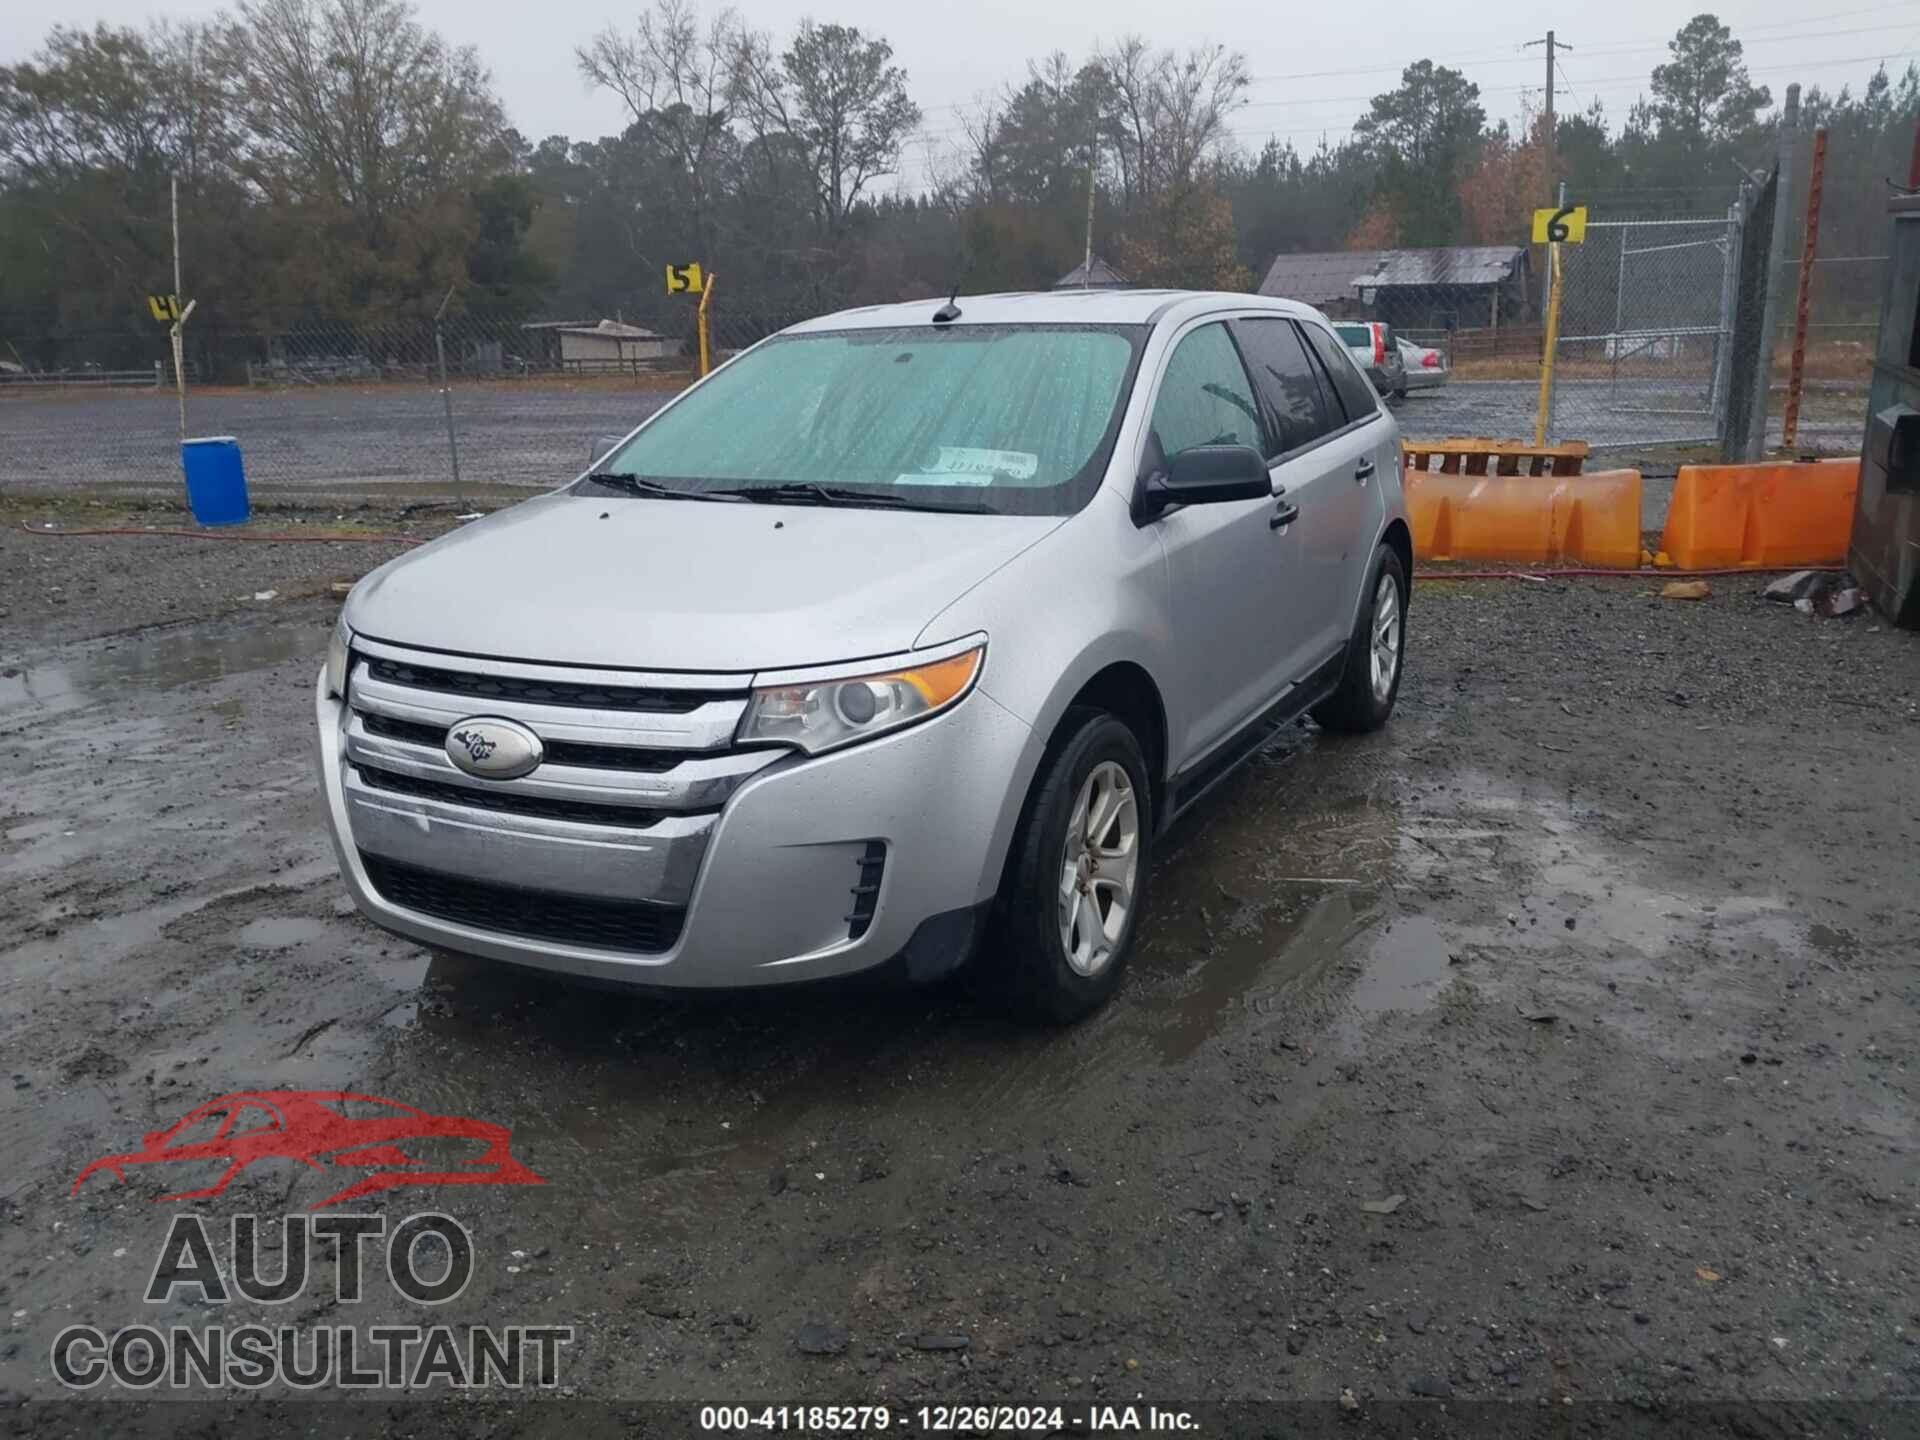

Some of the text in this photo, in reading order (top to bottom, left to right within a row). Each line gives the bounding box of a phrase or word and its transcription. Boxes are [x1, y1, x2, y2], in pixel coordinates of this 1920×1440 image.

[1548, 208, 1574, 242] 6
[673, 265, 690, 292] 5
[154, 295, 173, 319] 4
